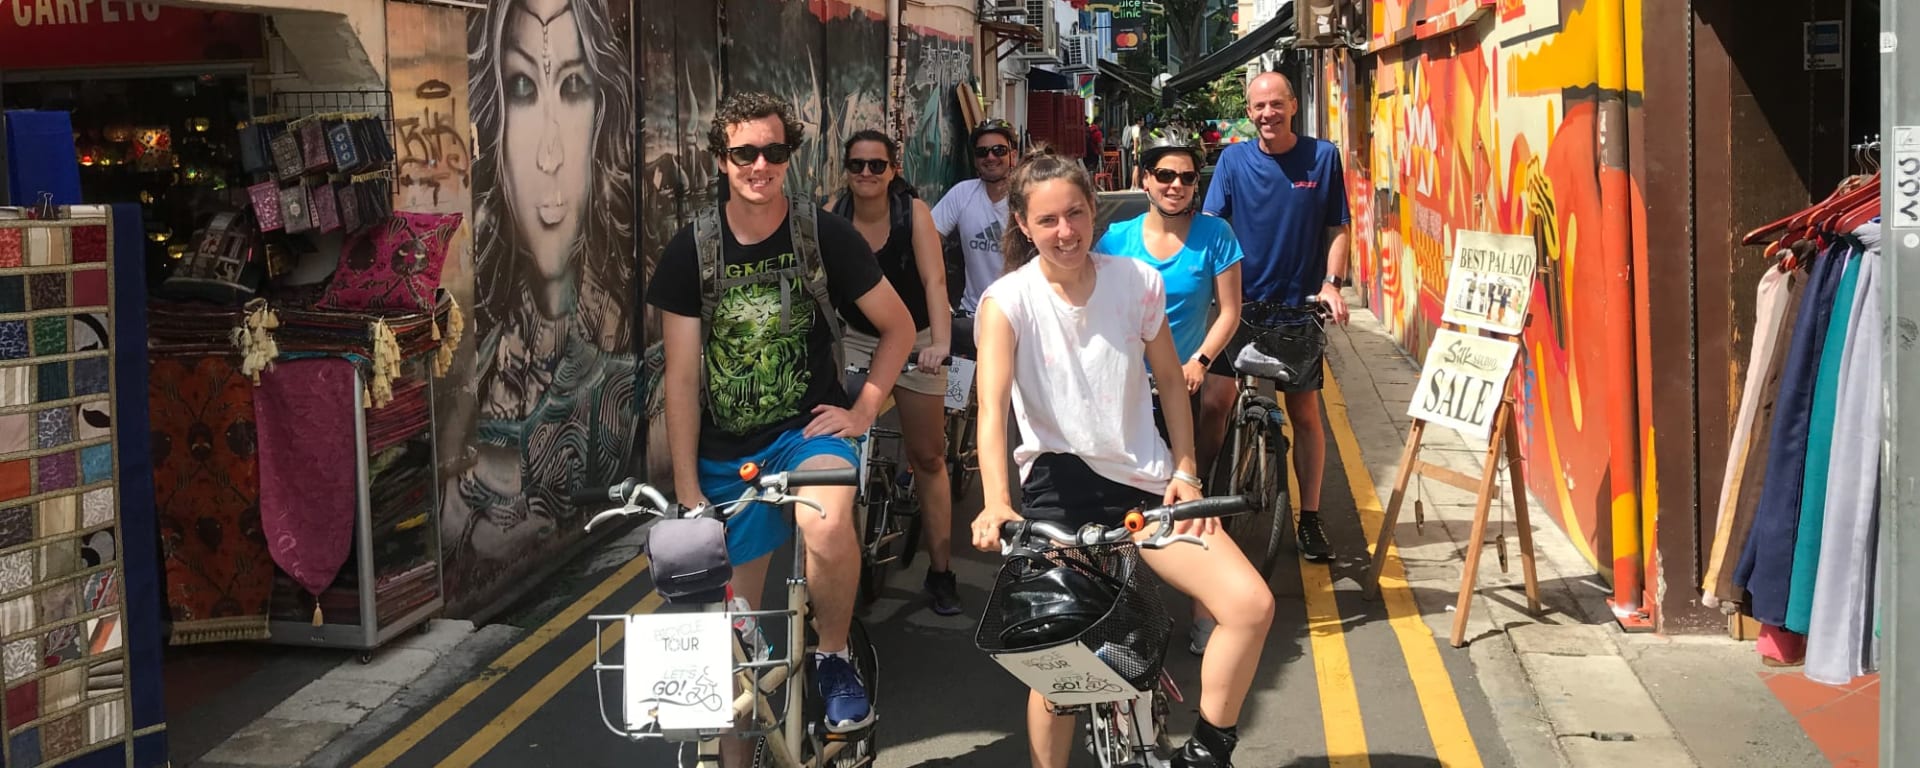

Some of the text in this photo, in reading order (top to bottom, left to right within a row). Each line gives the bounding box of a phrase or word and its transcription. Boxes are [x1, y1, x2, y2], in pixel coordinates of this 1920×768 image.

[1112, 8, 1142, 19] Clinic
[969, 239, 1001, 253] adid
[1460, 247, 1532, 277] BEST PALAZO
[1443, 339, 1473, 366] Silk
[1423, 368, 1494, 427] SALE
[653, 619, 704, 641] BICYCLE
[662, 636, 699, 652] TOUR
[652, 680, 687, 696] GO!
[1052, 681, 1081, 691] GO!
